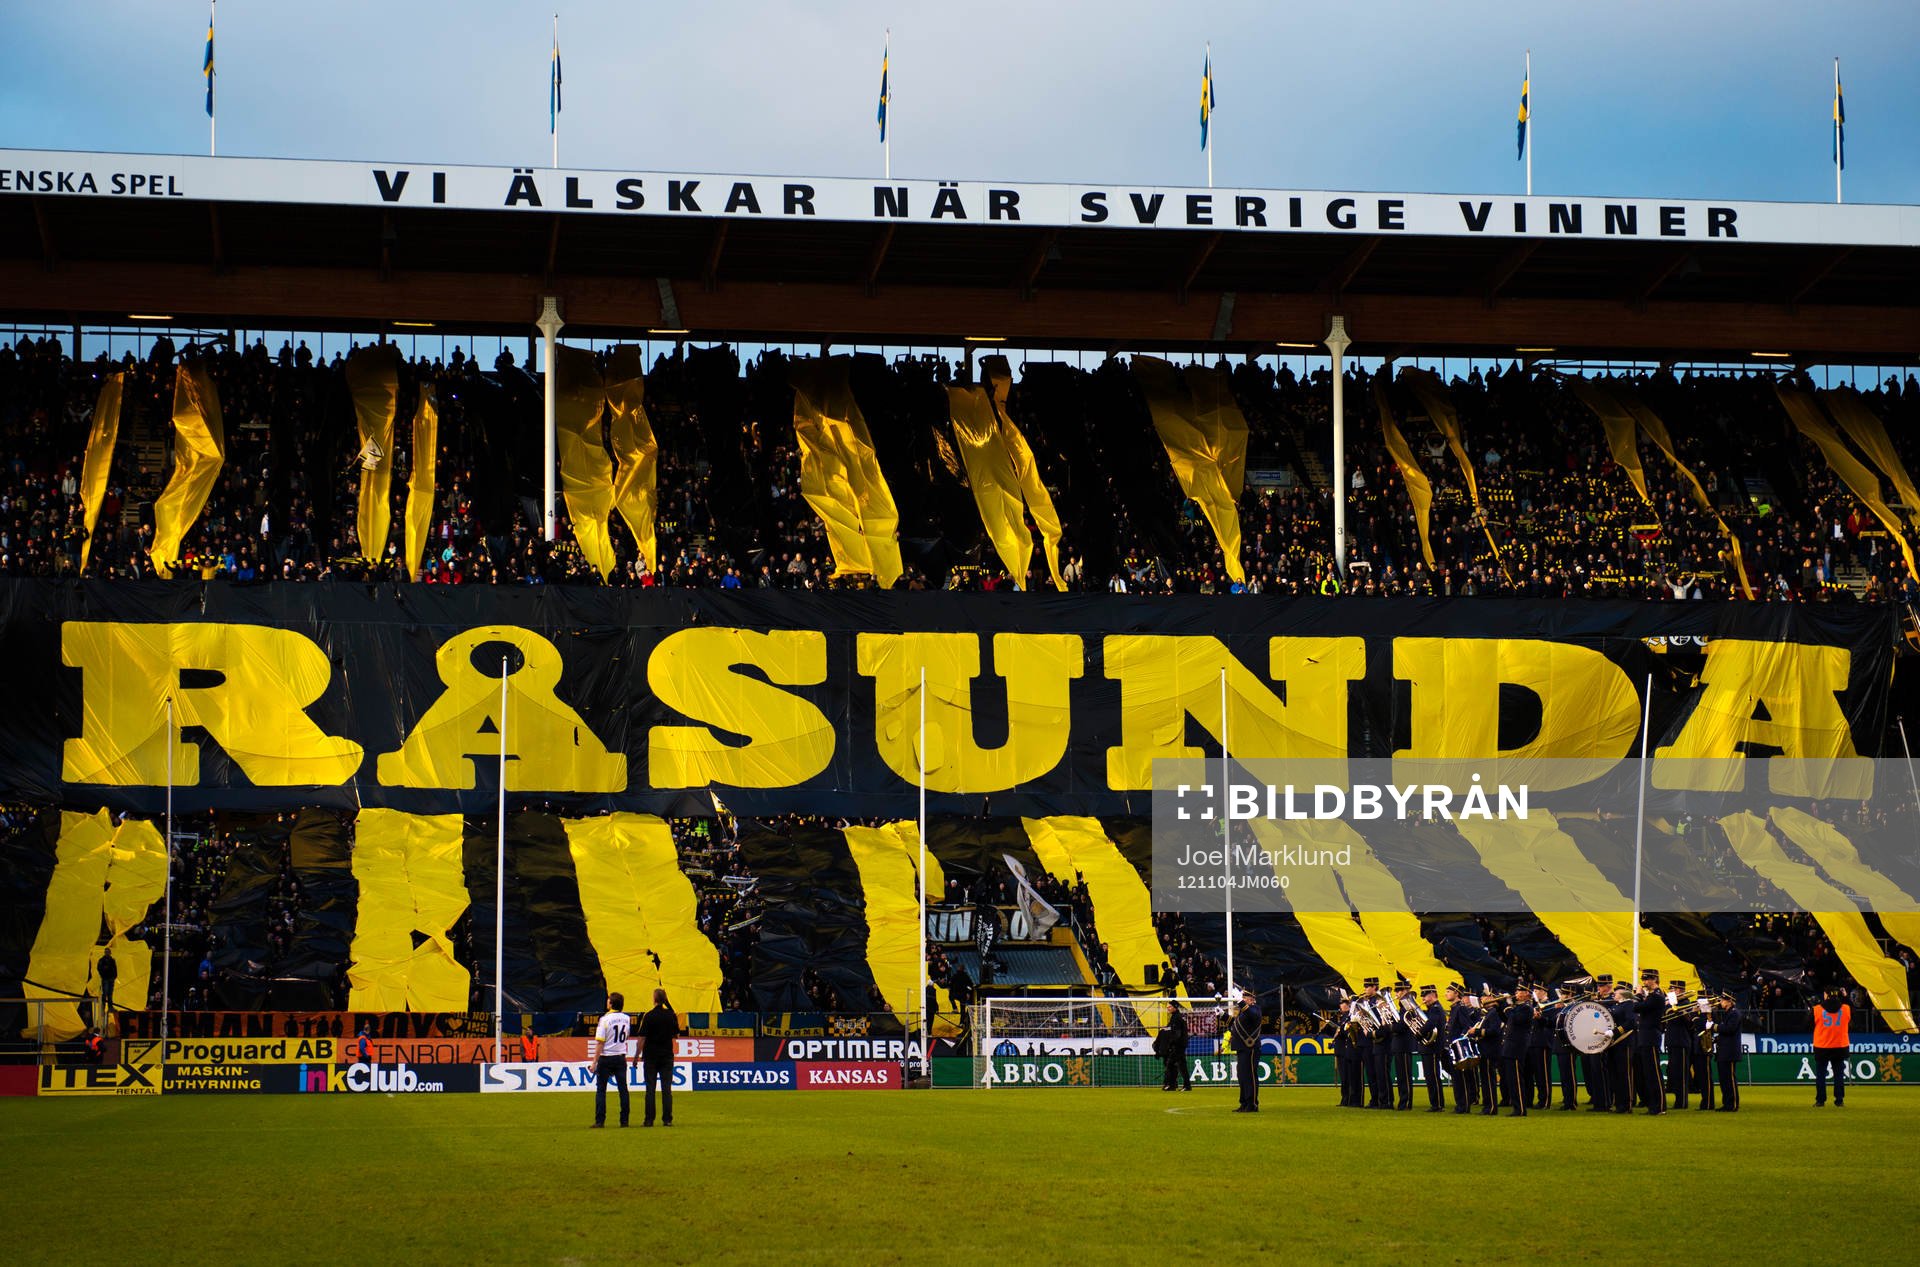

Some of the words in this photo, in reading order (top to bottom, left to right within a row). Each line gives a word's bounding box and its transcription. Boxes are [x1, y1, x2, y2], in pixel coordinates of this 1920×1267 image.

[0, 169, 98, 194] ENSKA
[111, 173, 184, 197] SPEL
[372, 170, 446, 204] VI
[504, 168, 816, 216] ÄLSKAR
[873, 181, 1021, 221] NÄR
[1080, 192, 1405, 230] SVERIGE
[1458, 201, 1738, 238] VINNER
[61, 621, 1874, 802] RÅSUNDA
[613, 1024, 626, 1043] 16
[166, 1039, 287, 1063] Proguard
[295, 1039, 333, 1059] AB
[344, 1044, 541, 1064] SENBOLAGE
[788, 1040, 923, 1059] OPTIMERA
[41, 1063, 156, 1088] ITEX
[177, 1066, 249, 1077] MASKIN-
[299, 1062, 444, 1092] inkClub.com
[536, 1065, 687, 1088] SAMLS
[697, 1069, 790, 1085] FRISTADS
[809, 1068, 889, 1085] KANSAS
[981, 1060, 1064, 1084] ÅBRO
[1189, 1058, 1272, 1082] ÅBO
[164, 1079, 262, 1090] UTHYRNING
